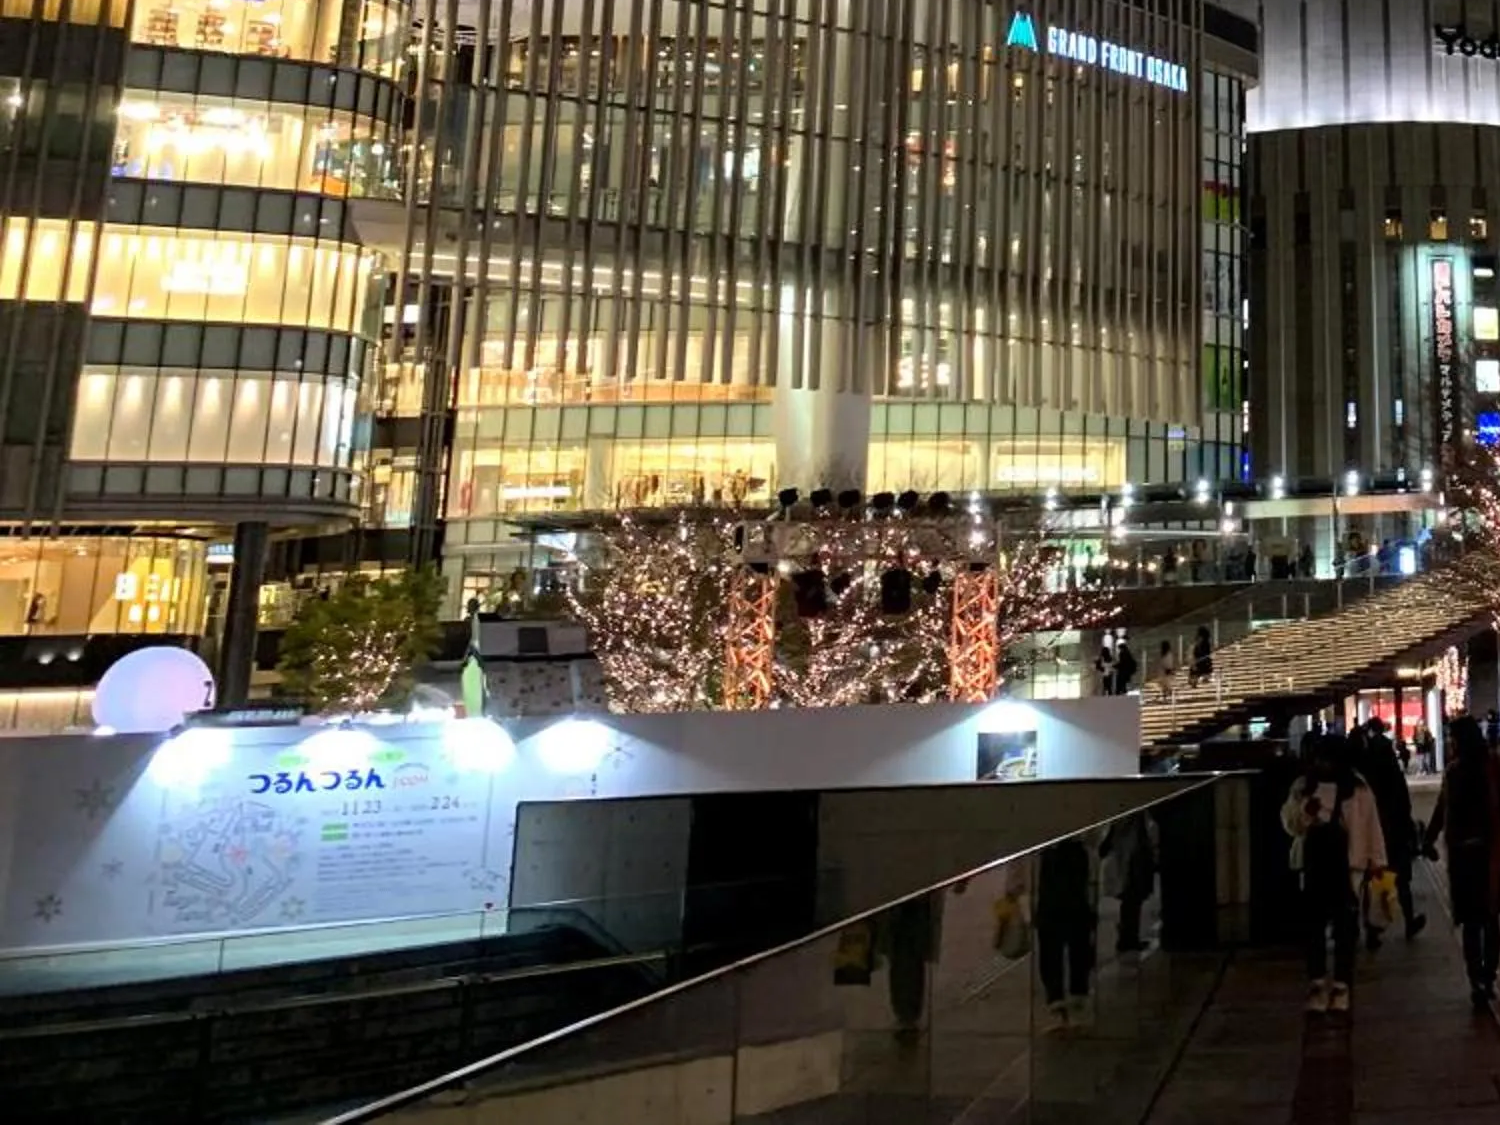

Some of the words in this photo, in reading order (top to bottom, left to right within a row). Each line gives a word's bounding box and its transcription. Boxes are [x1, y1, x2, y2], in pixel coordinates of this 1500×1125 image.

[1047, 25, 1097, 64] GRAND
[1101, 40, 1144, 78] FRONT
[1147, 56, 1188, 92] OSAKA
[247, 768, 385, 794] つるんつるん
